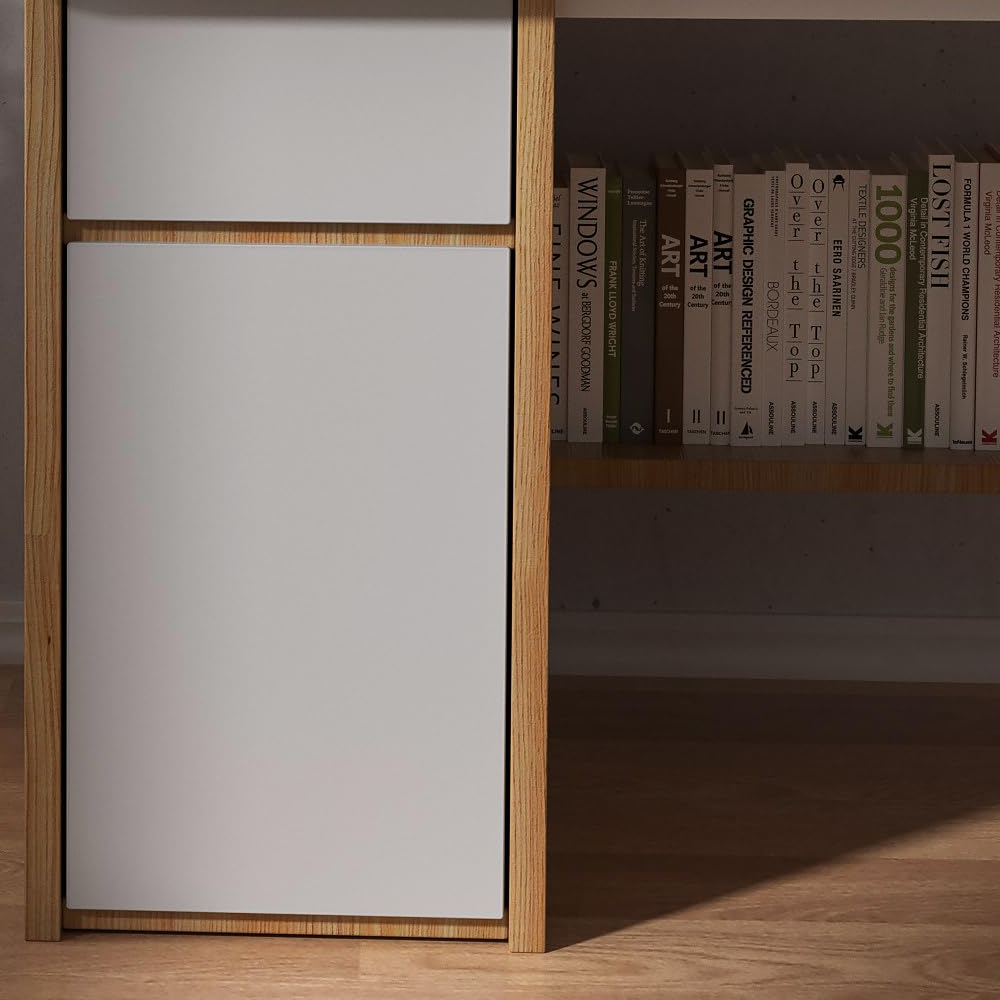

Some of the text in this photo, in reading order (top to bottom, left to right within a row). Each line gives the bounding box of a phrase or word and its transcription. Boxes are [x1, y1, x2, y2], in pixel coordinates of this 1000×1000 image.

[963, 178, 972, 222] FORMULA
[983, 191, 992, 255] Virginia McLeod
[576, 177, 598, 288] WINDOWS
[742, 198, 755, 255] GRAPHIC
[857, 184, 867, 269] TEXTILE DESIGNERS
[875, 185, 903, 264] 1000
[908, 197, 917, 260] Virginia McLeod
[930, 163, 952, 288] LOST FISH
[661, 234, 681, 277] ART
[689, 234, 708, 277] ART
[713, 230, 733, 273] ART
[962, 232, 971, 265] WORLD
[741, 259, 754, 306] DESIGN
[832, 239, 842, 317] EERO SAARINEN
[887, 267, 896, 292] designs
[917, 197, 928, 379] Detail in Contemporary Residential Architecture
[961, 267, 970, 321] CHAMPIONS
[580, 301, 592, 345] BERGDORF
[607, 260, 617, 358] FRANK LLOYD WRIGHT
[658, 301, 681, 309] Century
[687, 301, 708, 309] Century
[766, 281, 780, 352] BORDEAUX
[741, 310, 753, 394] REFERENCED
[886, 316, 896, 342] gardens
[888, 343, 896, 355] and
[580, 346, 592, 392] GOODMAN
[888, 356, 896, 377] where
